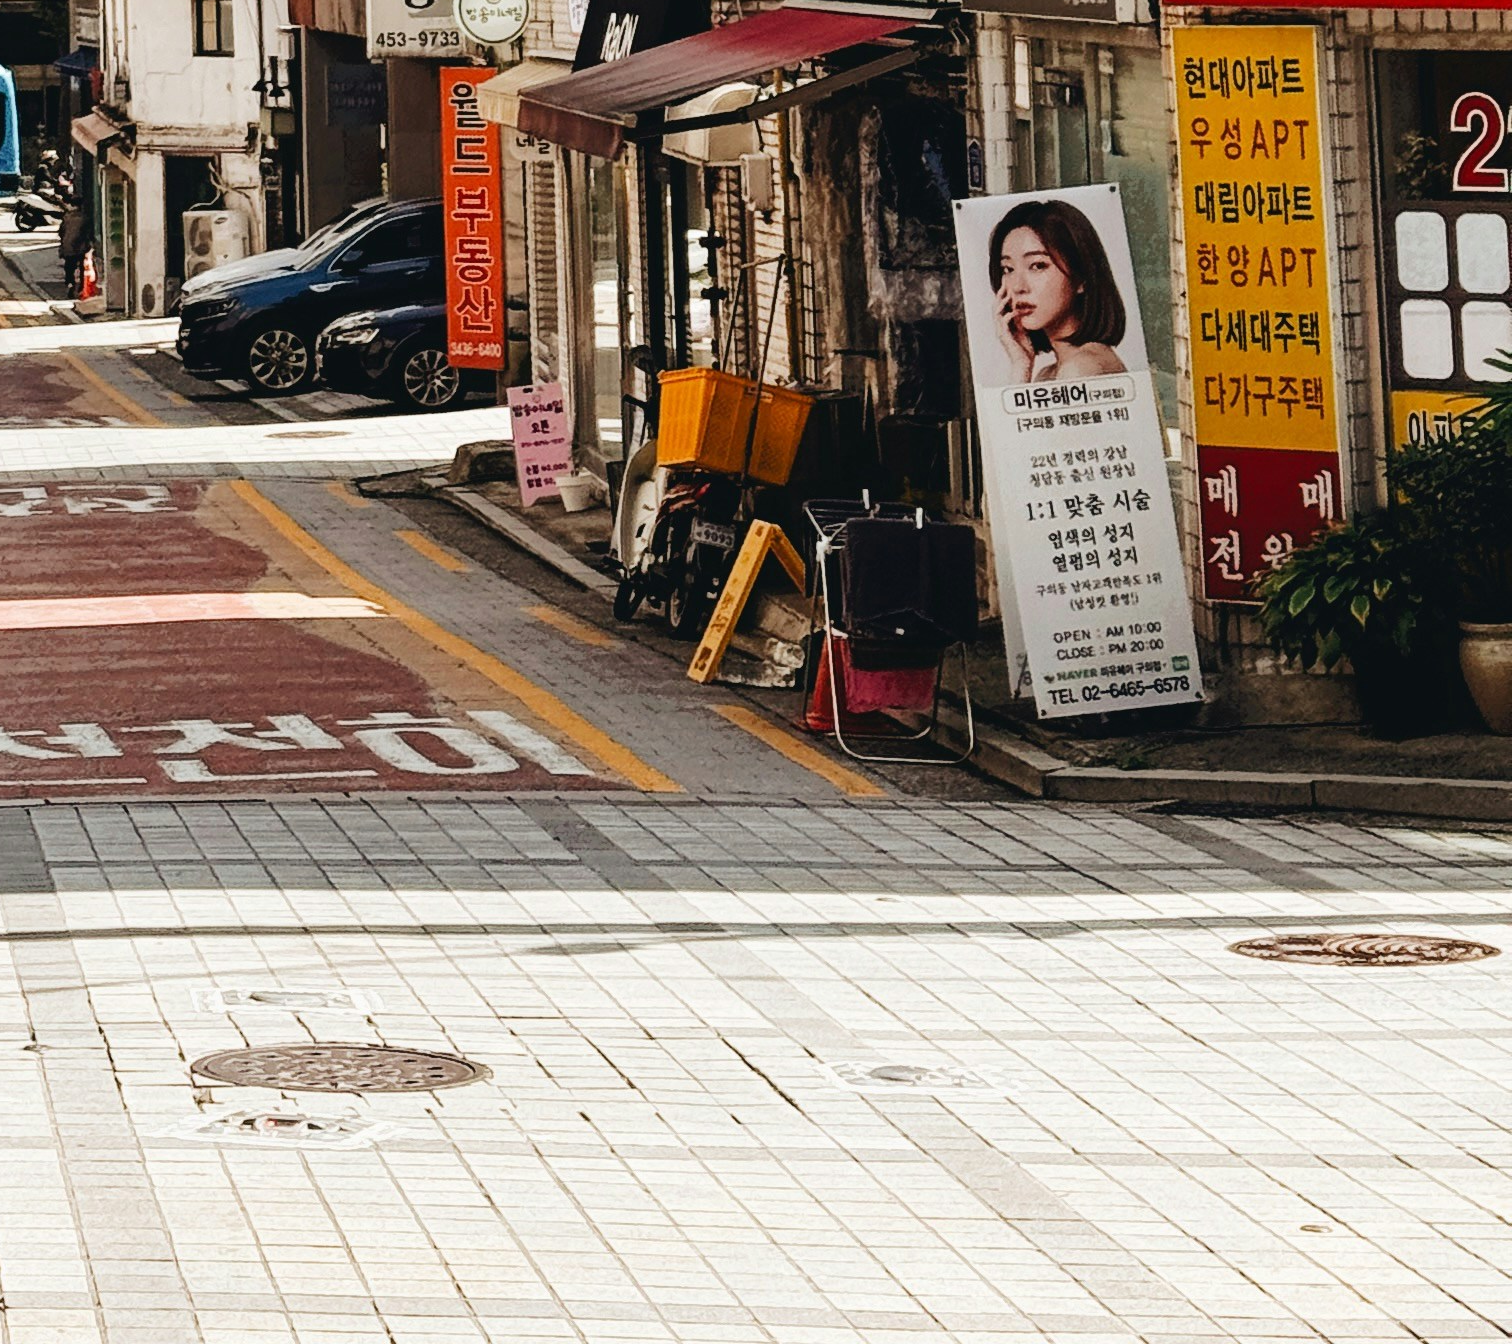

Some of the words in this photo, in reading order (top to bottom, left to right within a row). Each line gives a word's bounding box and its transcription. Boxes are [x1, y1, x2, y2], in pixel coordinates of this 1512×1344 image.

[375, 30, 460, 48] 453-9733
[1183, 55, 1305, 99] 현대아파트
[1194, 181, 1315, 226] 대림아파트
[451, 186, 497, 333] 부동산
[1200, 307, 1321, 357] 다세대주택
[1014, 383, 1089, 410] 미유헤어
[1203, 371, 1326, 421] 다가구주택
[1026, 498, 1059, 521] 1:1
[1063, 493, 1106, 520] 맞춤
[1113, 488, 1152, 513] 시술
[1103, 522, 1135, 544] 성지
[1052, 549, 1101, 573] 열펌의
[1107, 546, 1139, 567] 성지
[1053, 629, 1092, 644] OPEN
[1105, 625, 1125, 638] AM
[1128, 621, 1162, 636] 10:00
[1056, 645, 1097, 661] CLOSE
[1108, 641, 1127, 654] PM
[1130, 638, 1165, 653] 20:00
[1056, 667, 1099, 682] NAVER
[1047, 687, 1079, 705] TEL
[1081, 674, 1191, 703] 02-6465-6578
